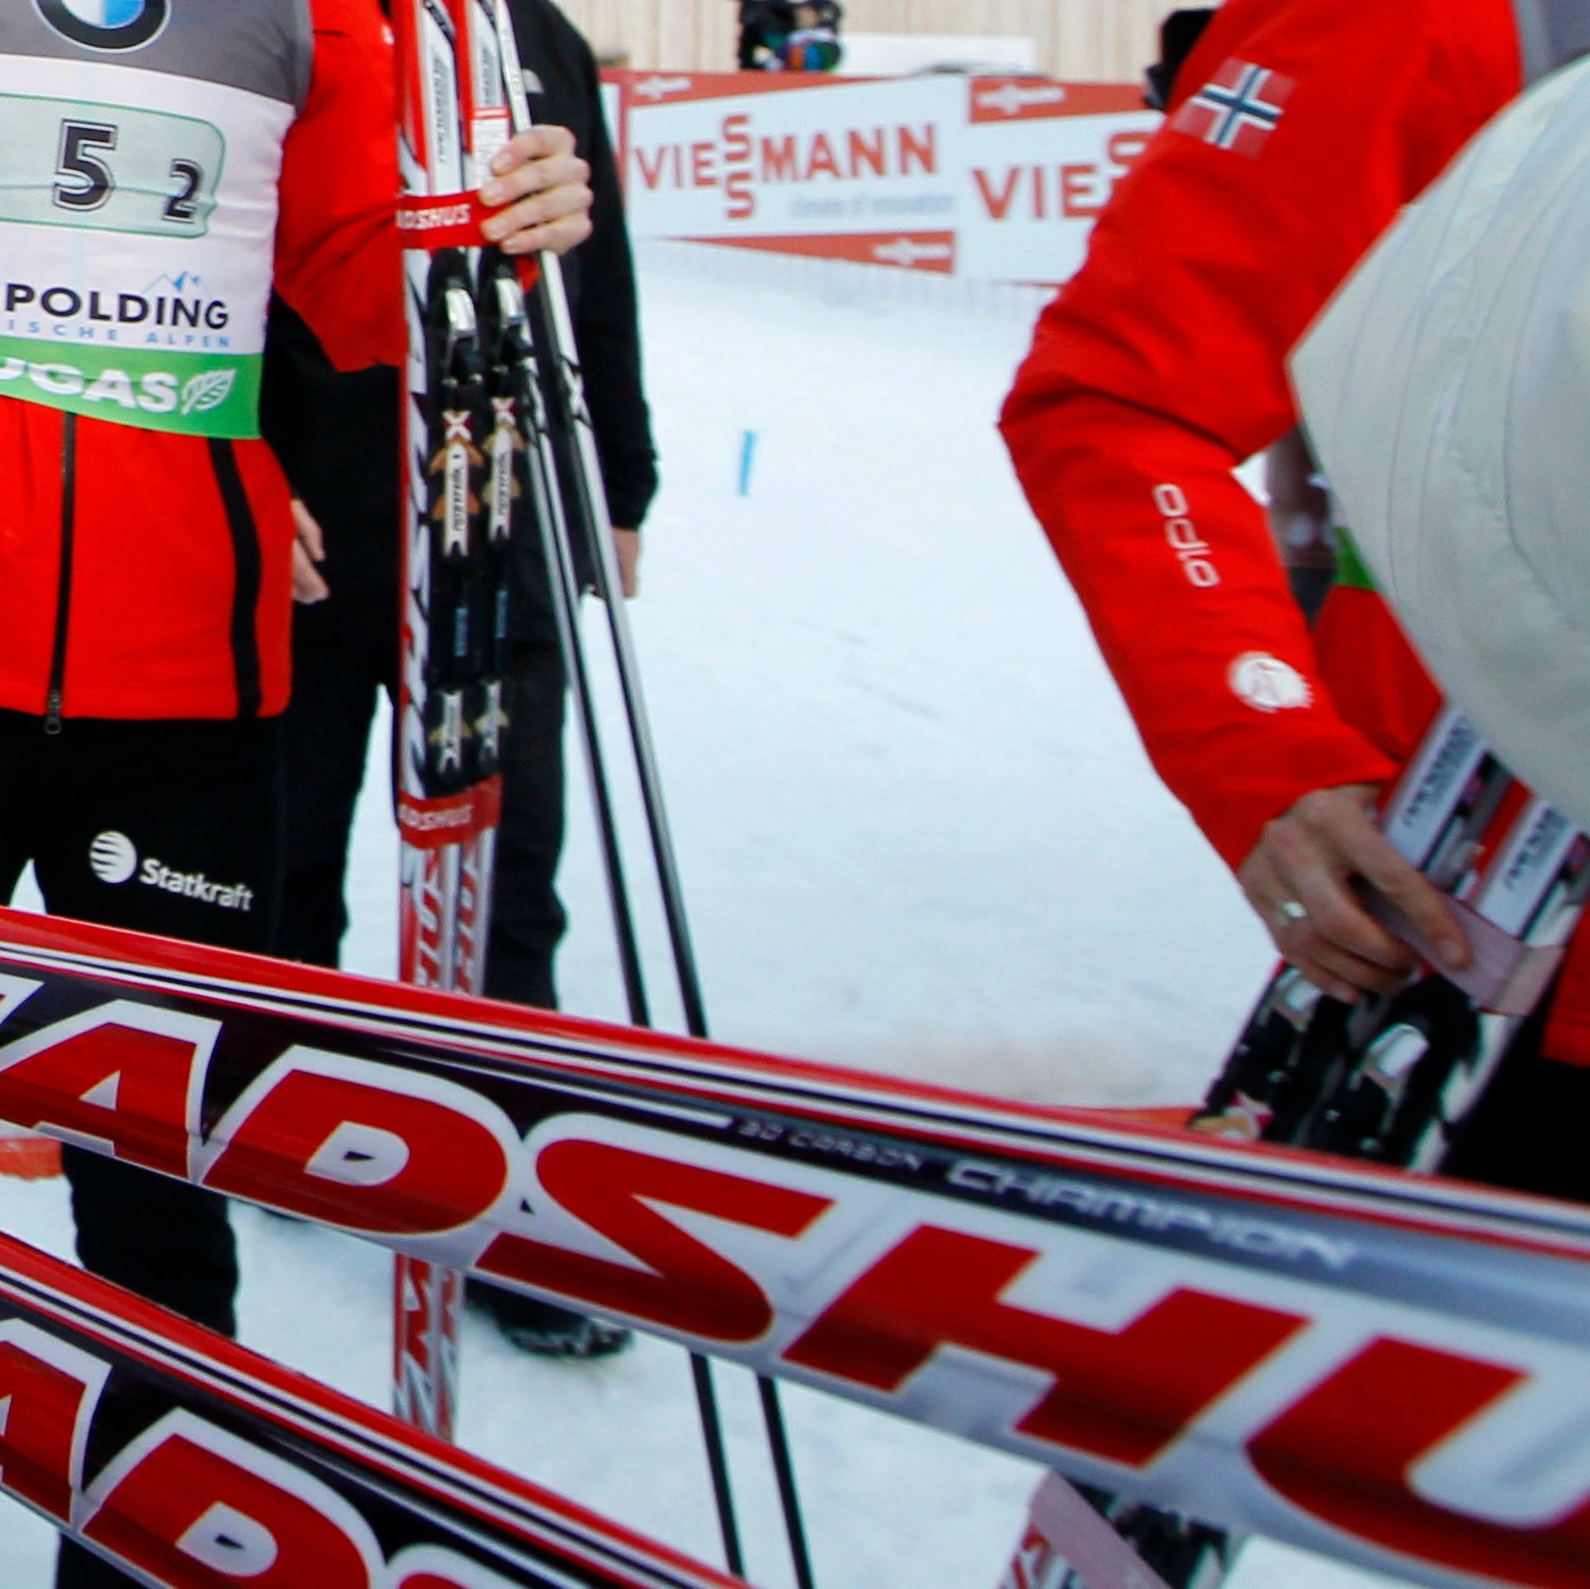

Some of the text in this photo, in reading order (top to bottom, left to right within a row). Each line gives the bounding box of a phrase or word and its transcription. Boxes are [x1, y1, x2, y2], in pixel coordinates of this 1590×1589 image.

[54, 119, 204, 223] 5 2
[635, 114, 937, 219] VIESSMANN
[147, 331, 230, 348] ALPEN
[1153, 482, 1220, 589] odlo
[139, 857, 253, 911] Statkraft
[945, 1158, 1355, 1270] CHAMPION
